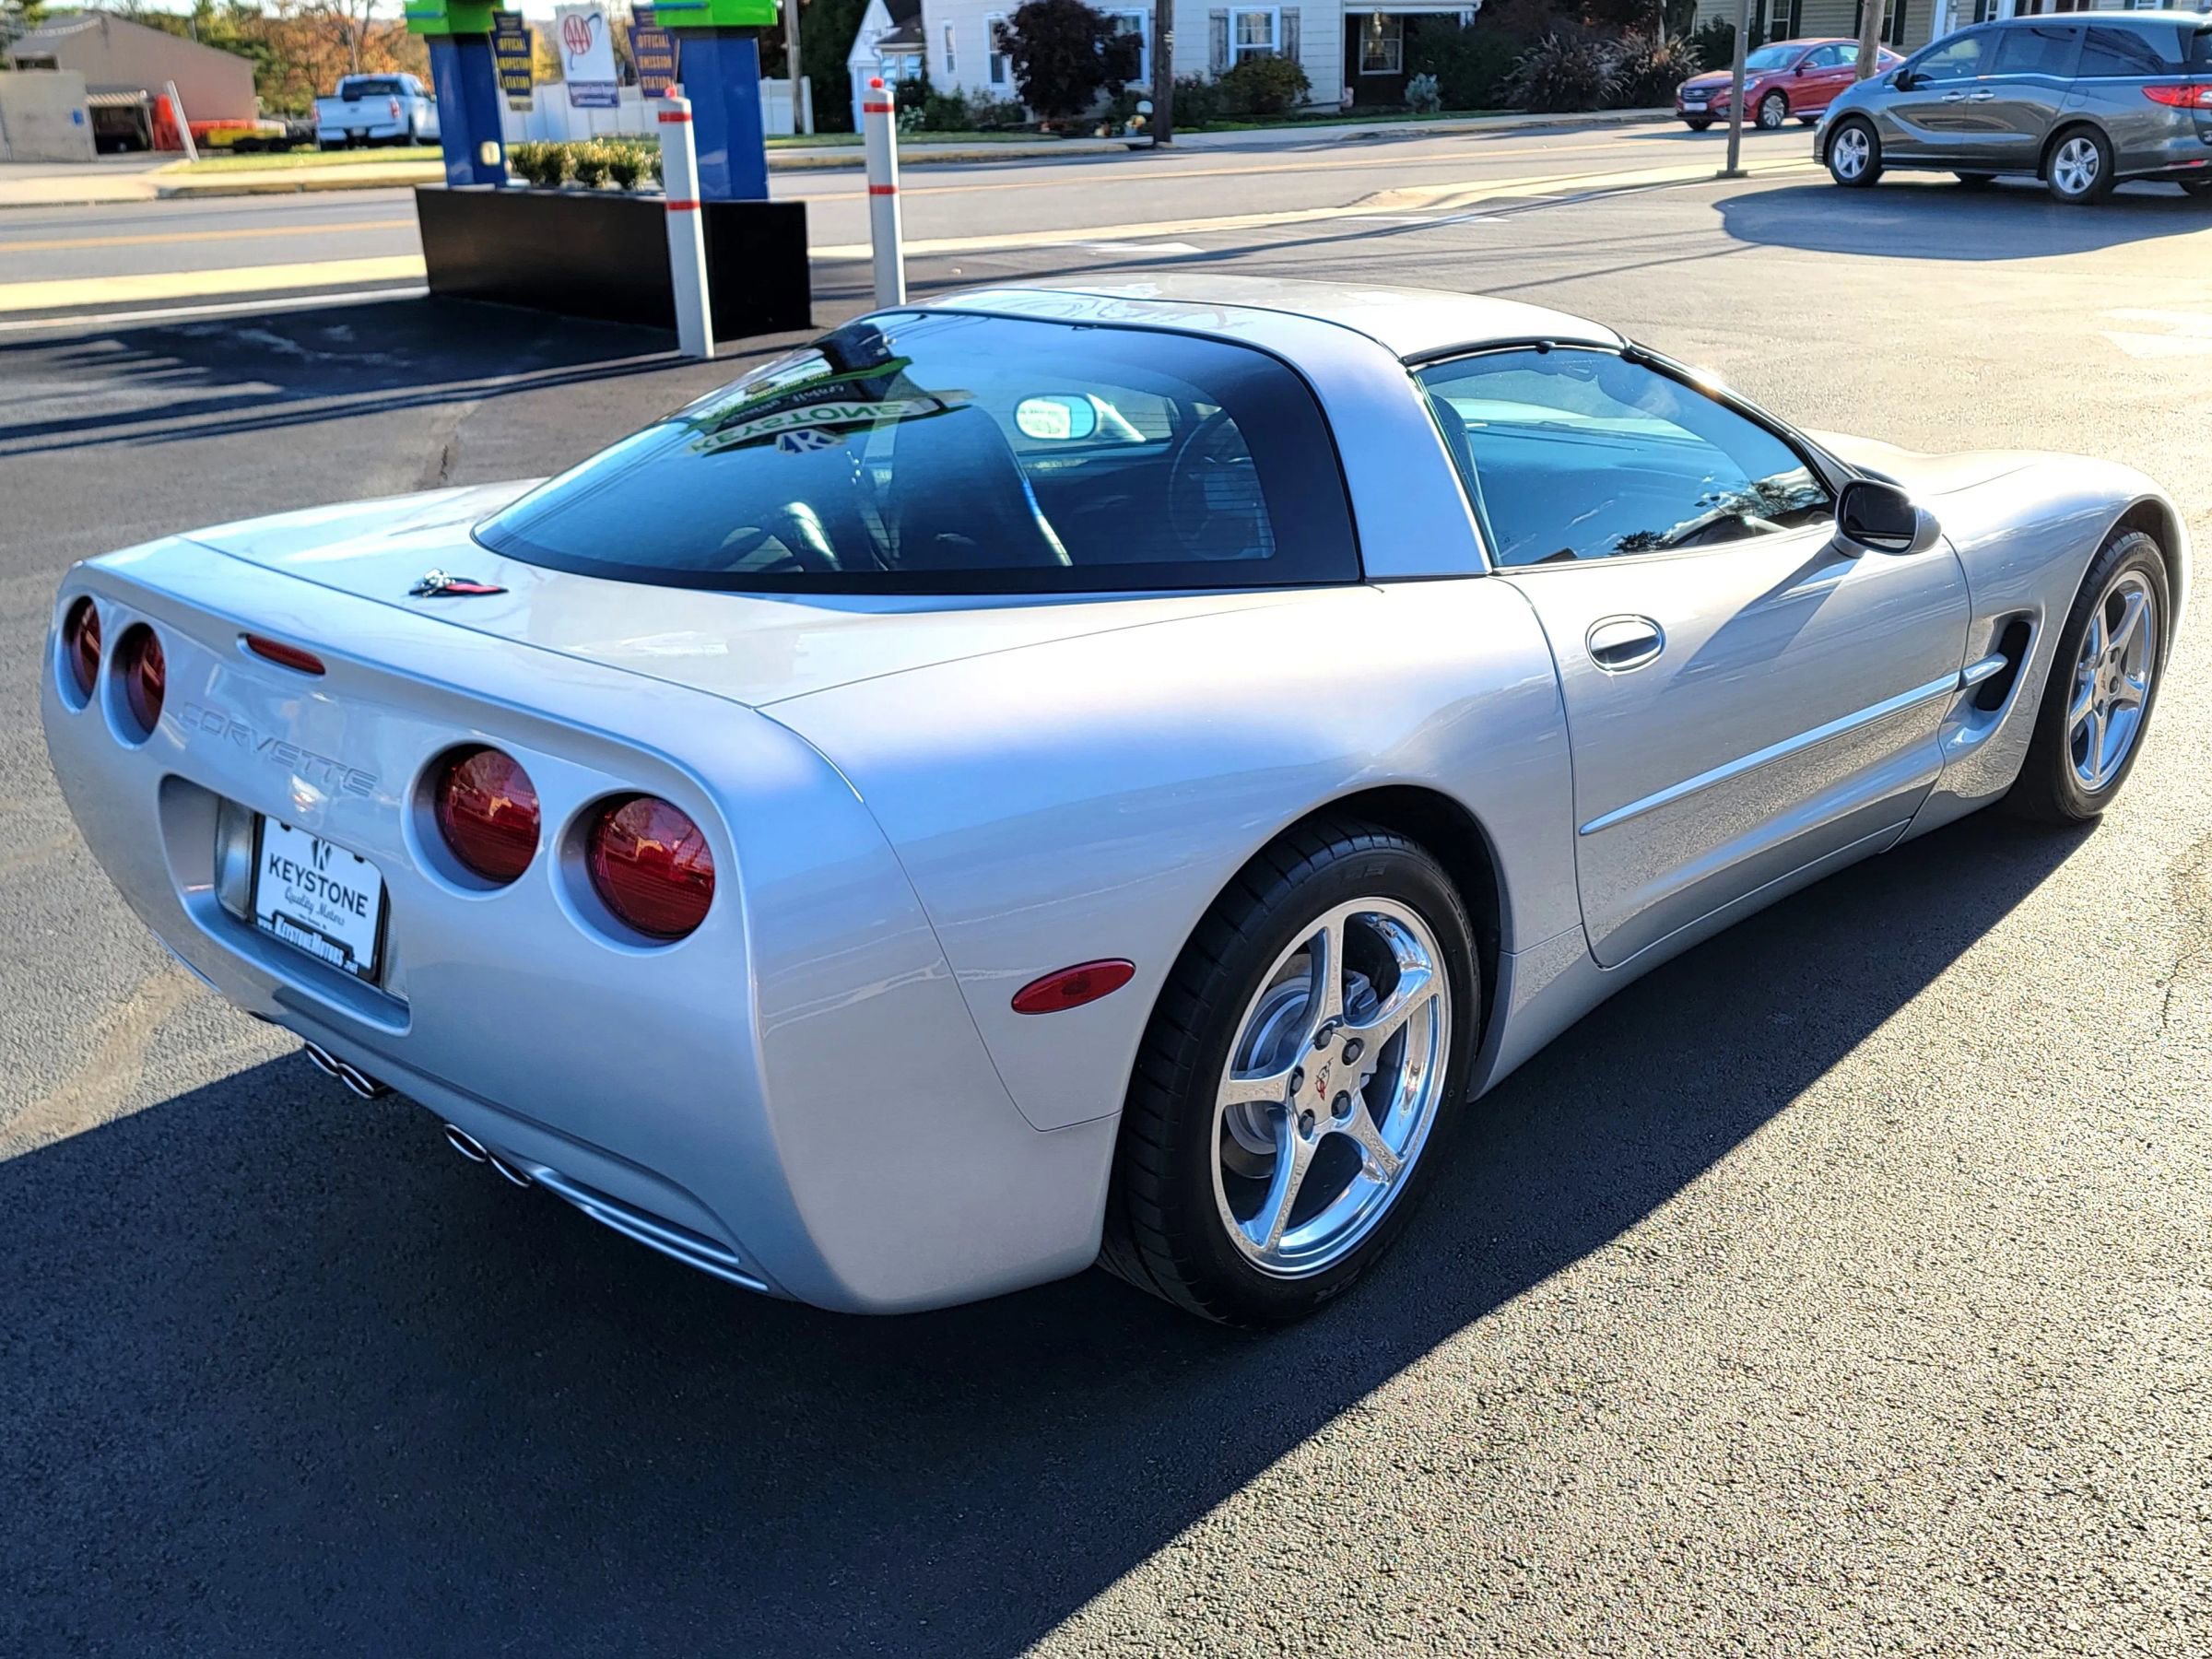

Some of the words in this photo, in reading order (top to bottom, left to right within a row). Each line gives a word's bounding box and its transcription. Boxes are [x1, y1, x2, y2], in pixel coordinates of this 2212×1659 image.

[498, 38, 526, 52] OFFICIAL
[565, 16, 591, 50] AAA
[636, 34, 670, 49] OFFICIAL
[505, 76, 530, 88] STATION
[179, 701, 377, 795] CORVETTE
[268, 852, 369, 919] KEYSTONE
[284, 885, 315, 915] Quality
[315, 901, 346, 926] Motors
